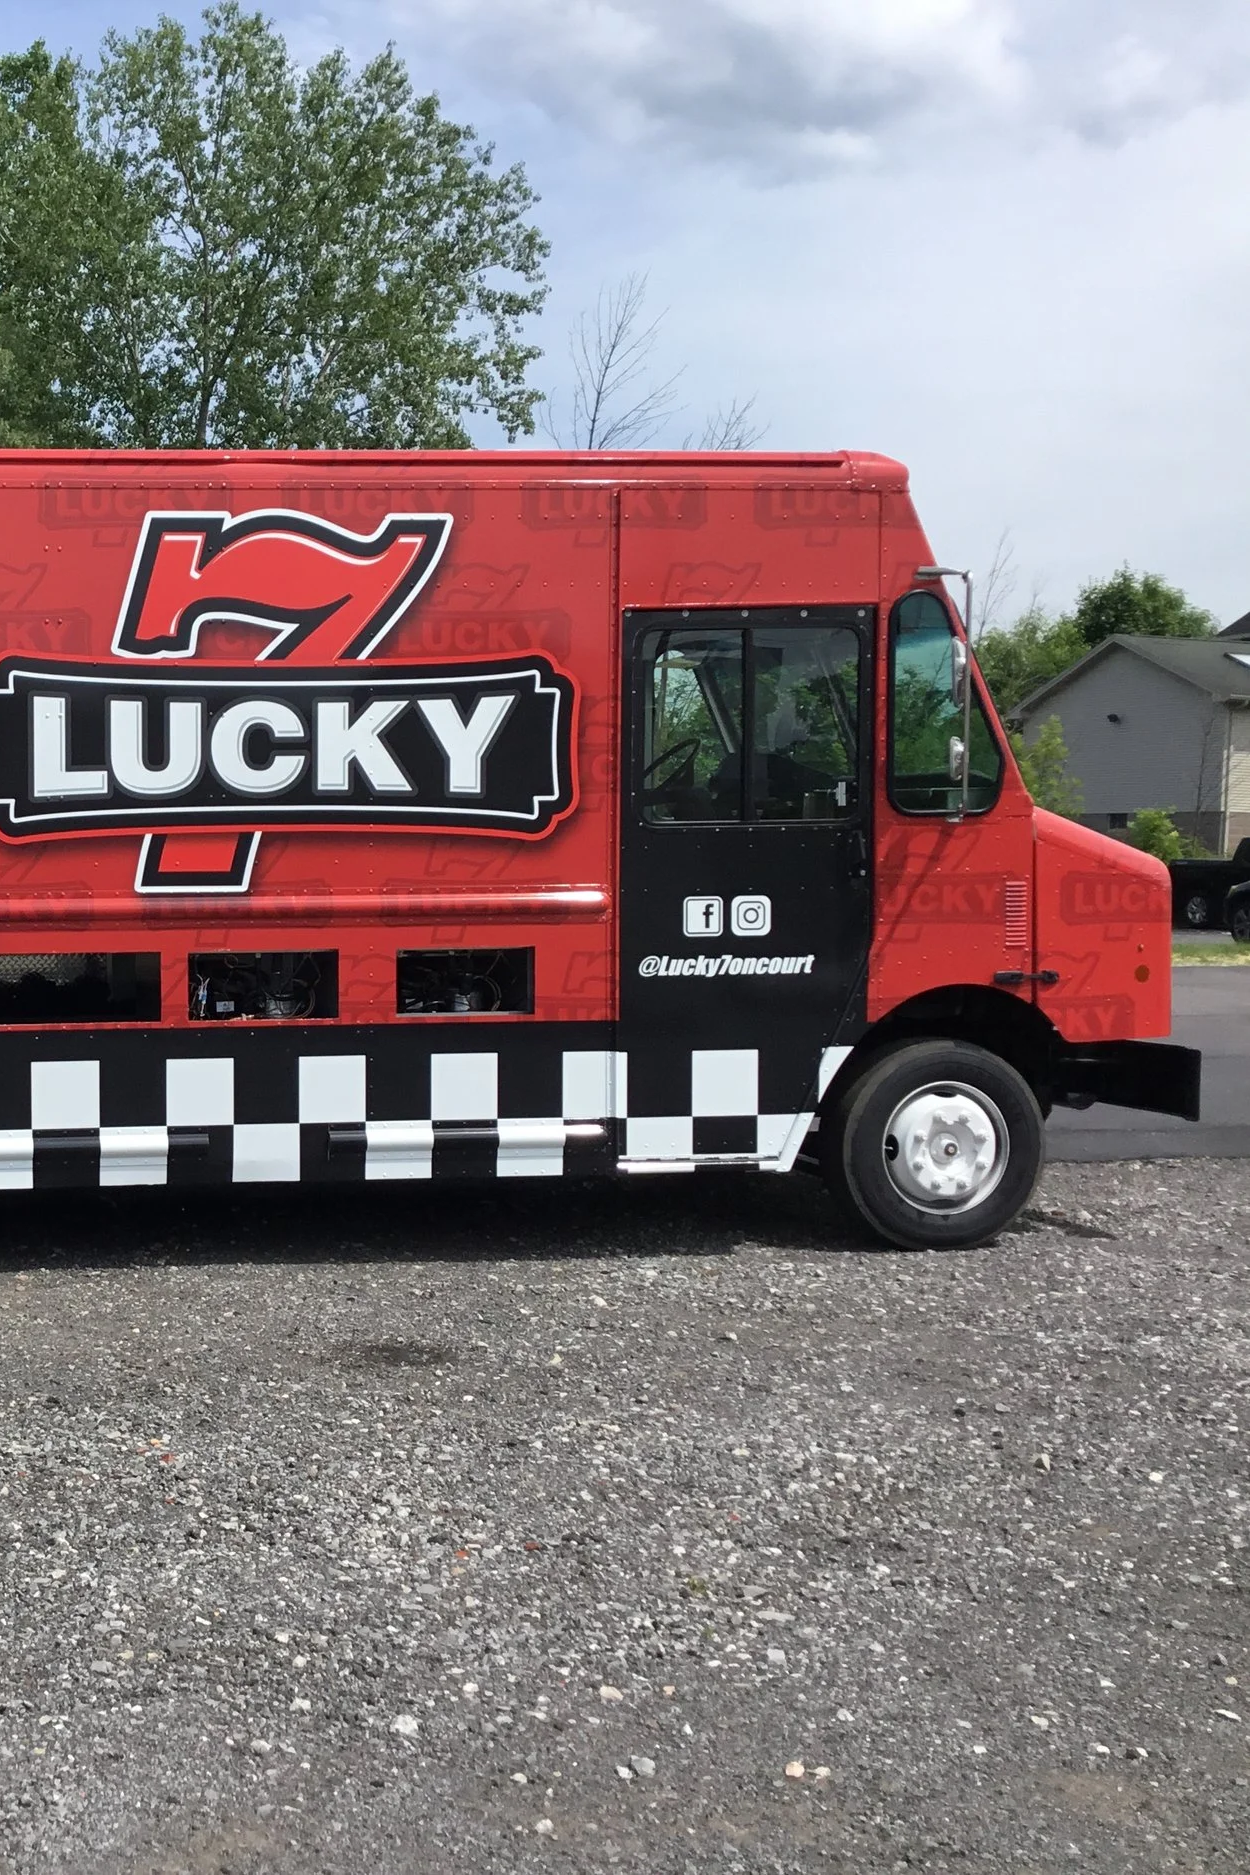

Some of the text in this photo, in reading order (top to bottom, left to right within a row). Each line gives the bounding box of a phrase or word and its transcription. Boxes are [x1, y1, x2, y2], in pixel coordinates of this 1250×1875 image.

[33, 695, 516, 798] LUCKY
[878, 883, 1000, 913] UCKY
[638, 954, 815, 978] @Lucky7oncourt
